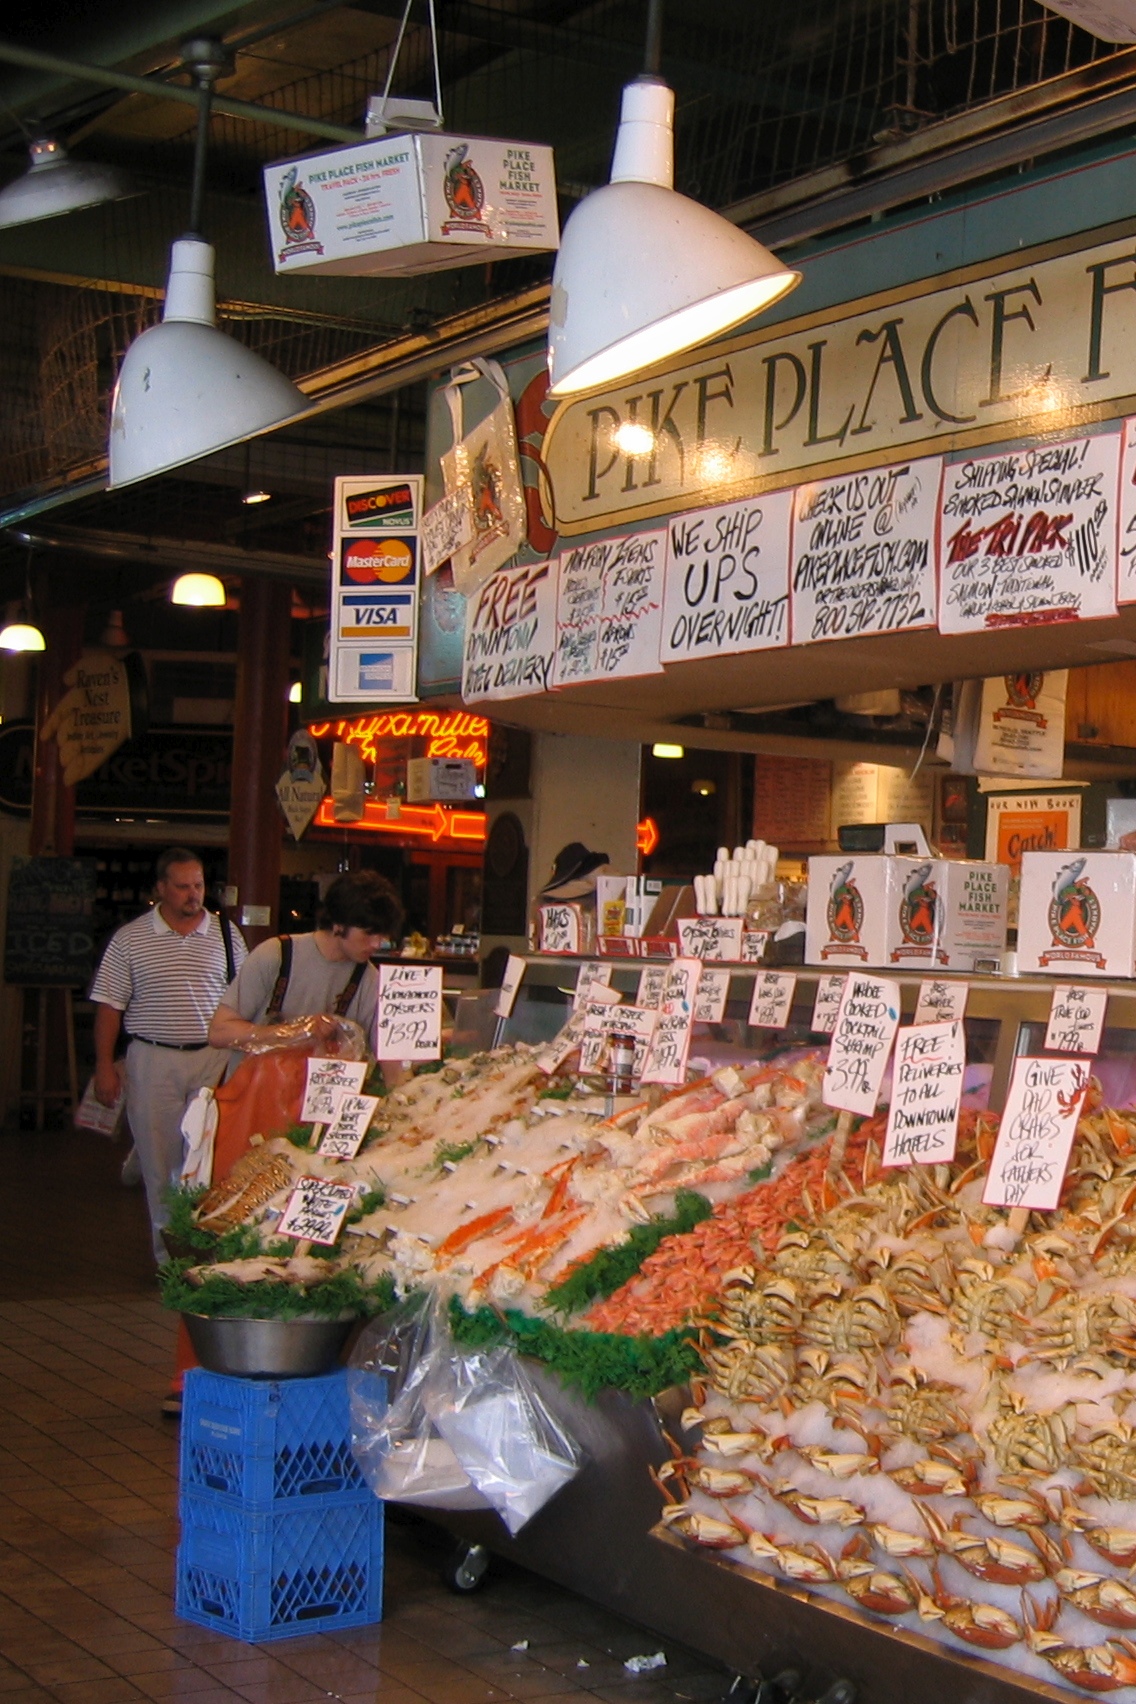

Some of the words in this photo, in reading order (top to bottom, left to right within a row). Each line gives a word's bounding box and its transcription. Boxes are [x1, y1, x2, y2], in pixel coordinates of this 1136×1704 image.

[503, 159, 535, 172] PLACE
[507, 149, 531, 161] PIKE
[308, 171, 328, 184] PIKE
[328, 165, 355, 180] PLACE
[355, 160, 375, 174] FISH
[376, 152, 411, 169] MARKET
[508, 171, 531, 181] FISH
[499, 181, 541, 192] MARKET
[581, 362, 742, 501] PIKE
[758, 277, 1052, 459] PLACE
[955, 455, 1018, 491] SHIPPING
[846, 475, 869, 511] US
[868, 465, 911, 510] OUT
[348, 486, 412, 516] DISCOVER
[671, 519, 703, 560] WE
[703, 507, 764, 555] SHIP
[809, 512, 867, 551] ONLINE
[872, 502, 894, 537] @
[346, 554, 410, 570] MasterCard
[685, 545, 762, 608] UPS
[473, 565, 550, 630] FREE
[353, 607, 399, 626] VISA
[670, 594, 791, 652] OVERNIGHT!
[811, 604, 848, 640] 800
[77, 666, 119, 689] Raven's
[84, 688, 109, 708] Nest
[71, 707, 122, 727] Treasure
[964, 881, 998, 893] PLACE
[969, 871, 993, 882] PIKE
[958, 902, 1001, 914] MARKET
[969, 892, 992, 902] FISH
[843, 1000, 888, 1019] COOKED
[839, 1017, 892, 1041] COCKTAIL
[834, 1035, 885, 1058] SHRIMP
[899, 1061, 963, 1084] DELIVERIES
[1025, 1060, 1068, 1088] GIVE
[897, 1088, 918, 1106] TO
[917, 1082, 944, 1099] ALL
[1022, 1088, 1053, 1113] DAD
[893, 1098, 959, 1132] DOWNTOWN
[1008, 1114, 1062, 1141] CRABS
[888, 1129, 948, 1159] HOTELS
[1011, 1140, 1045, 1162] FOR
[1000, 1160, 1059, 1185] FATHERS
[1003, 1182, 1031, 1207] DAY
